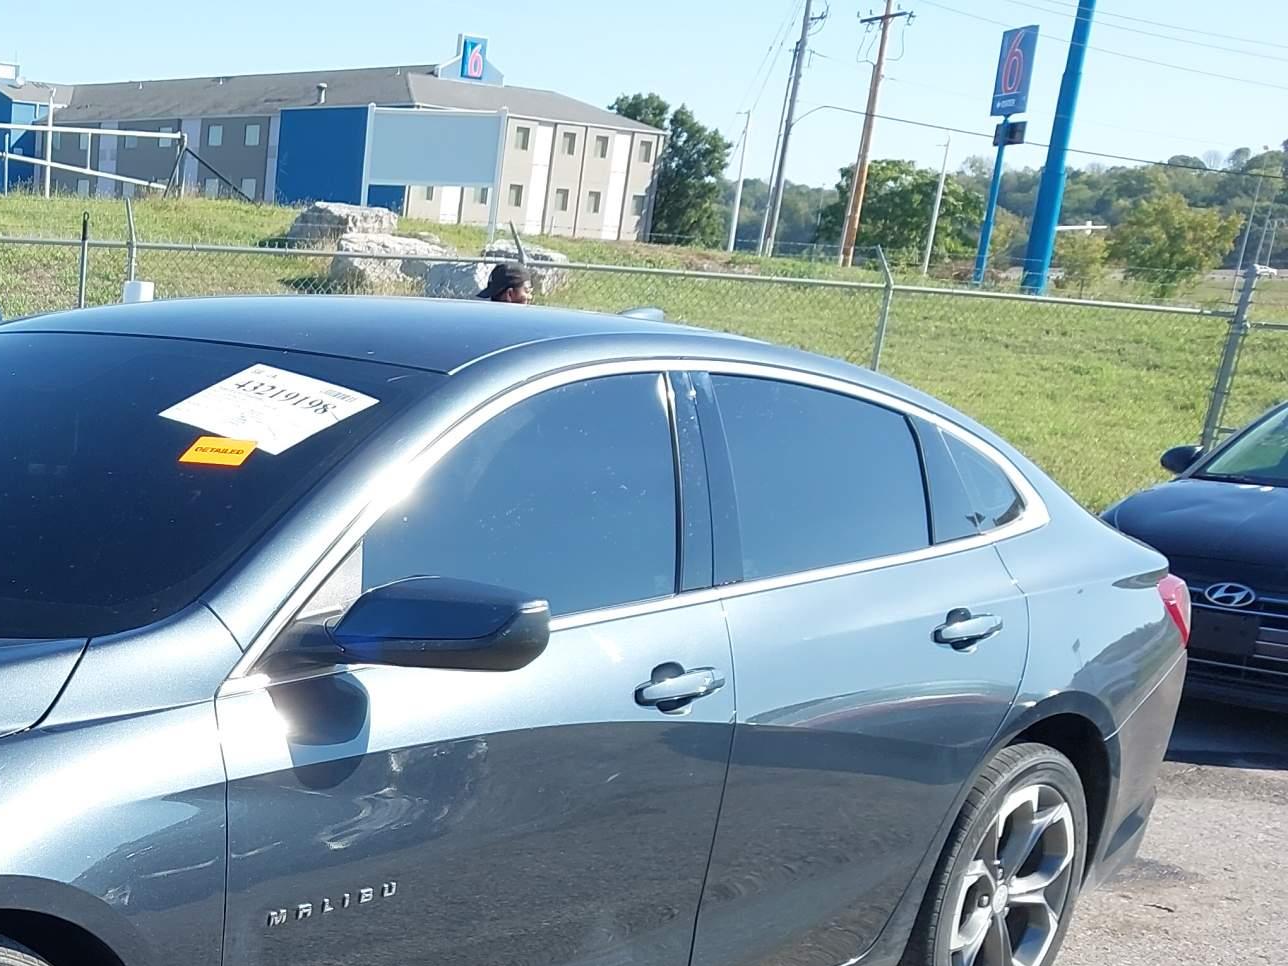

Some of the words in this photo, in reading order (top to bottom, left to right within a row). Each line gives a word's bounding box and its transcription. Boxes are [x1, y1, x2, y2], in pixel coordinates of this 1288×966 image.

[468, 43, 483, 77] 6
[1001, 28, 1024, 95] 6
[234, 379, 337, 414] 43219198
[194, 446, 245, 456] DETAILED
[268, 881, 397, 927] MALIBU
